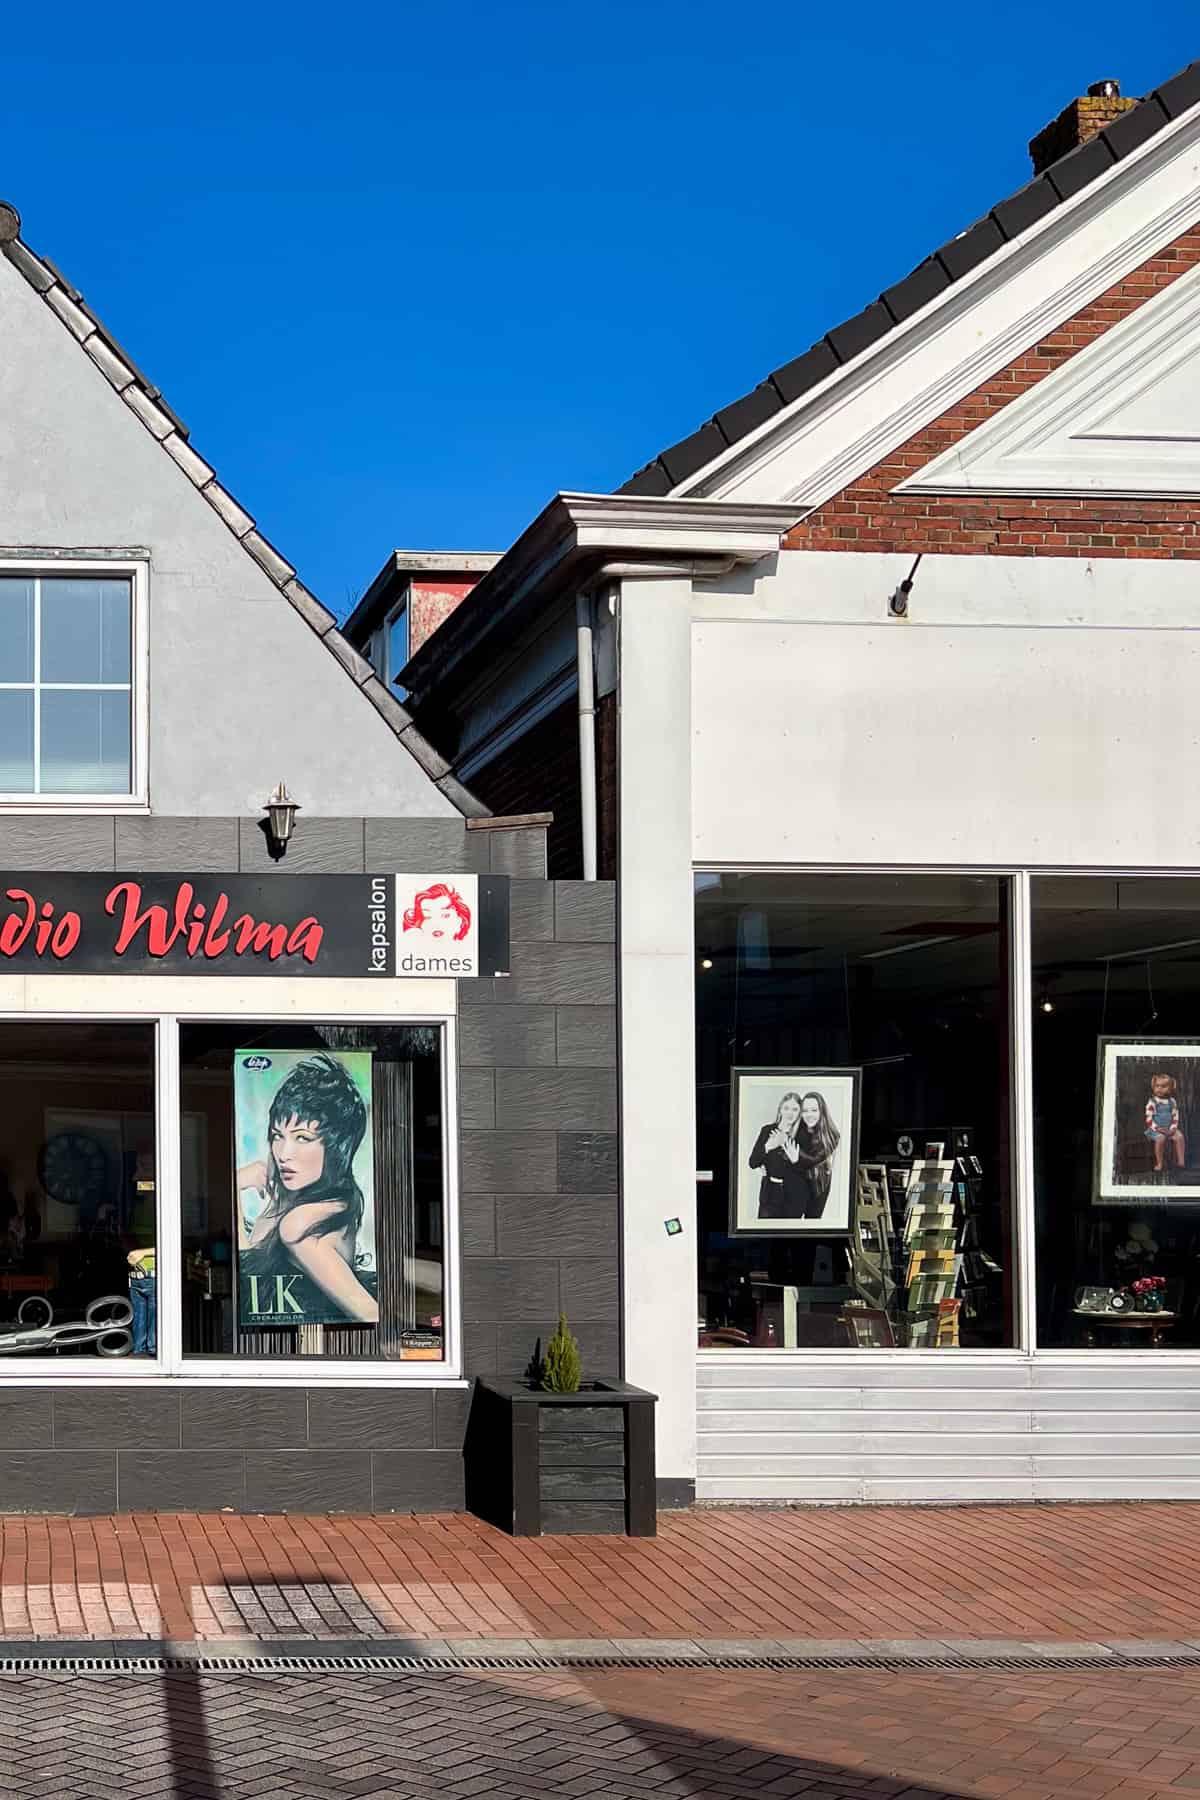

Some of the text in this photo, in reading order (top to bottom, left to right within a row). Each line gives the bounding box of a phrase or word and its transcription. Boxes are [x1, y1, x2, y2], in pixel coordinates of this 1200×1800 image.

[104, 882, 325, 964] Wilma
[367, 877, 390, 973] kapsalon
[401, 954, 473, 973] dames
[247, 1274, 306, 1314] LK
